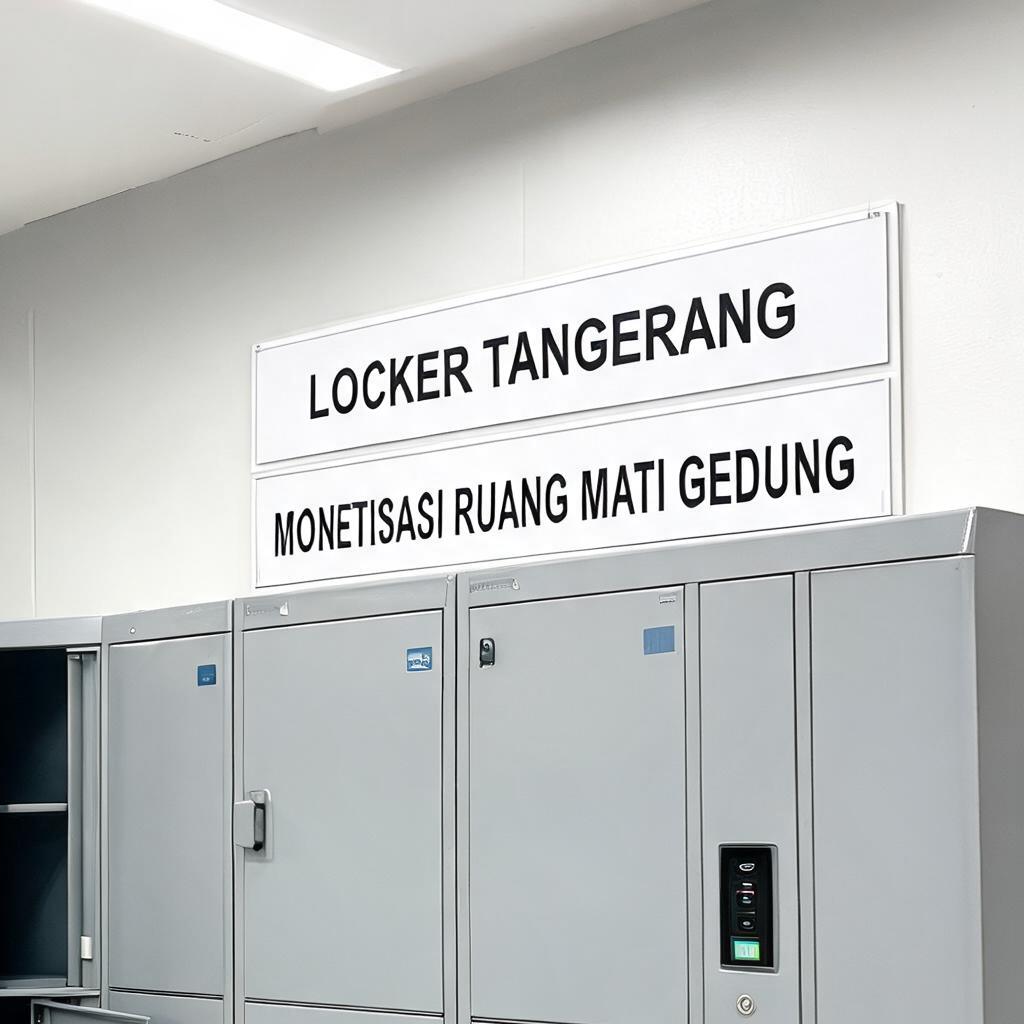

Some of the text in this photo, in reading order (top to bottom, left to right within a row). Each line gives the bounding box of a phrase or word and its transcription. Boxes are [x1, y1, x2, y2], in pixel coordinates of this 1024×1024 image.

[310, 282, 796, 420] LOCKER TANGERANG
[274, 435, 855, 557] MONETISASI RUANG MATI GEDUNG
